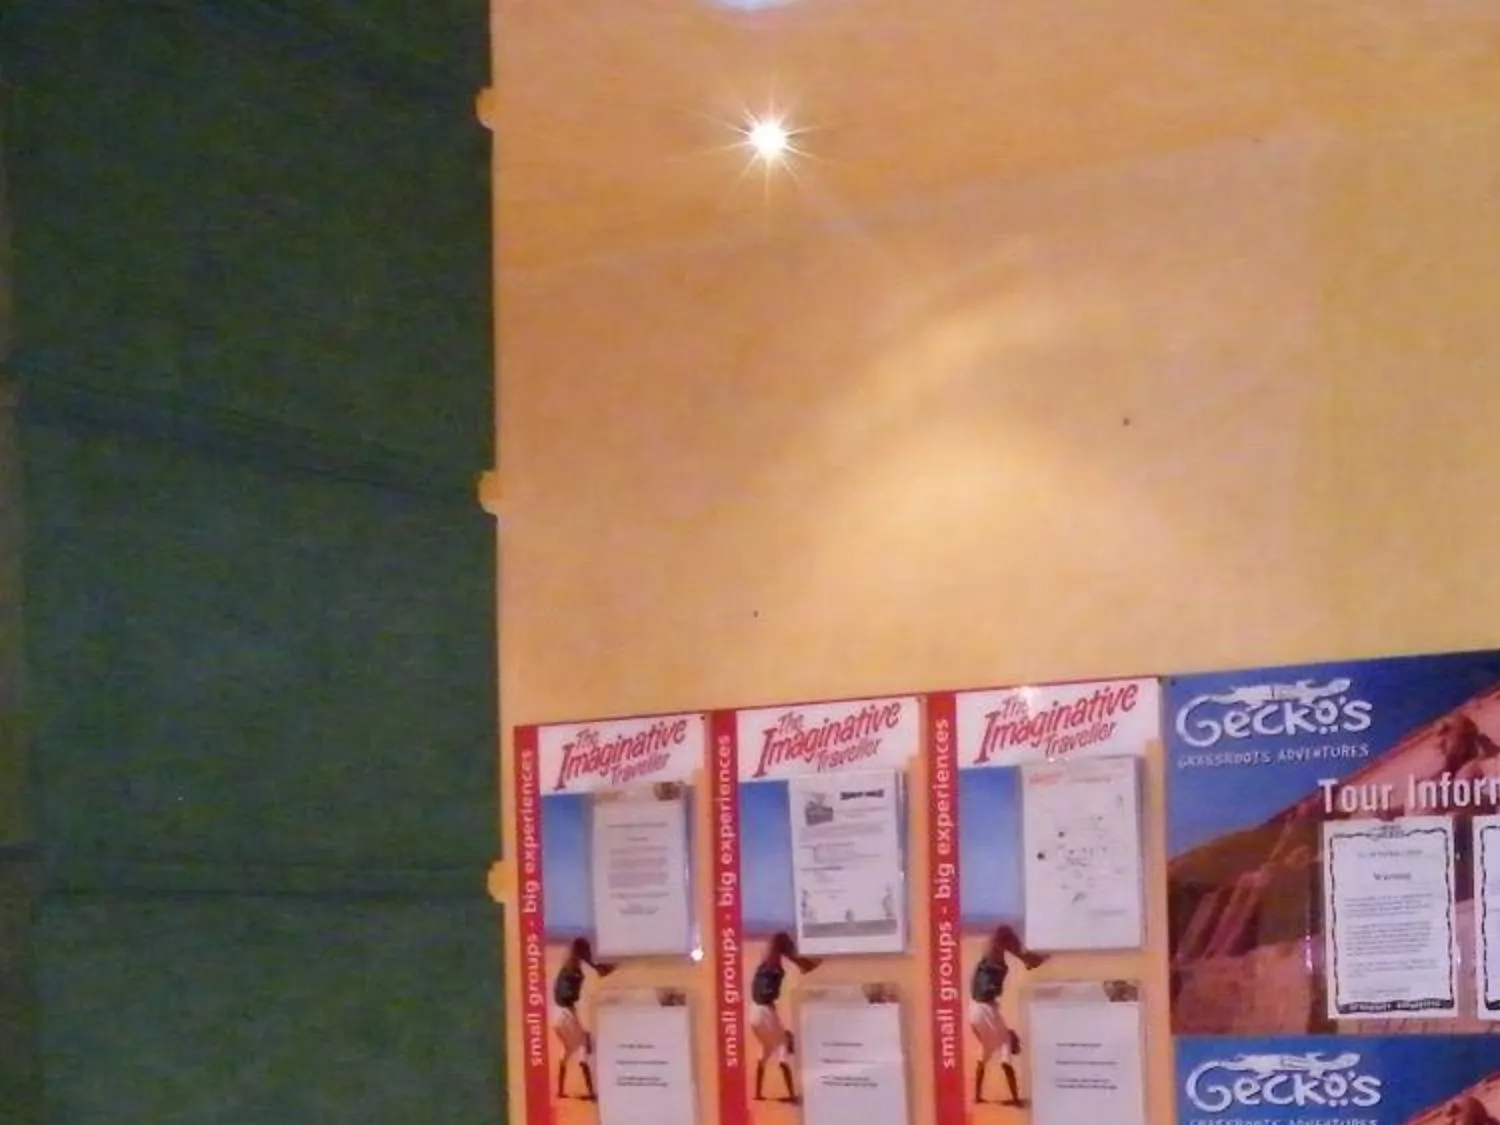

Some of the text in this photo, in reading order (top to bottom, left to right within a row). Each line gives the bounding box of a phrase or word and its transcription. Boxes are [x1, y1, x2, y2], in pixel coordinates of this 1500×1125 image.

[553, 719, 687, 791] Imaginative
[752, 702, 901, 778] Imaginative
[973, 684, 1138, 764] Imaginative
[1044, 722, 1117, 757] Traveller
[611, 752, 671, 785] Traveller
[816, 738, 882, 773] Traveller
[520, 748, 540, 874] experiences
[717, 735, 738, 864] experiences
[932, 718, 954, 856] experiences
[1317, 777, 1394, 814] Tour
[522, 879, 541, 914] big
[717, 868, 737, 907] big
[934, 862, 956, 900] big
[525, 934, 543, 1006] groups
[721, 927, 739, 1003] groups
[935, 921, 956, 1000] groups
[527, 1012, 543, 1068] small
[723, 1012, 738, 1068] small
[936, 1008, 955, 1070] small
